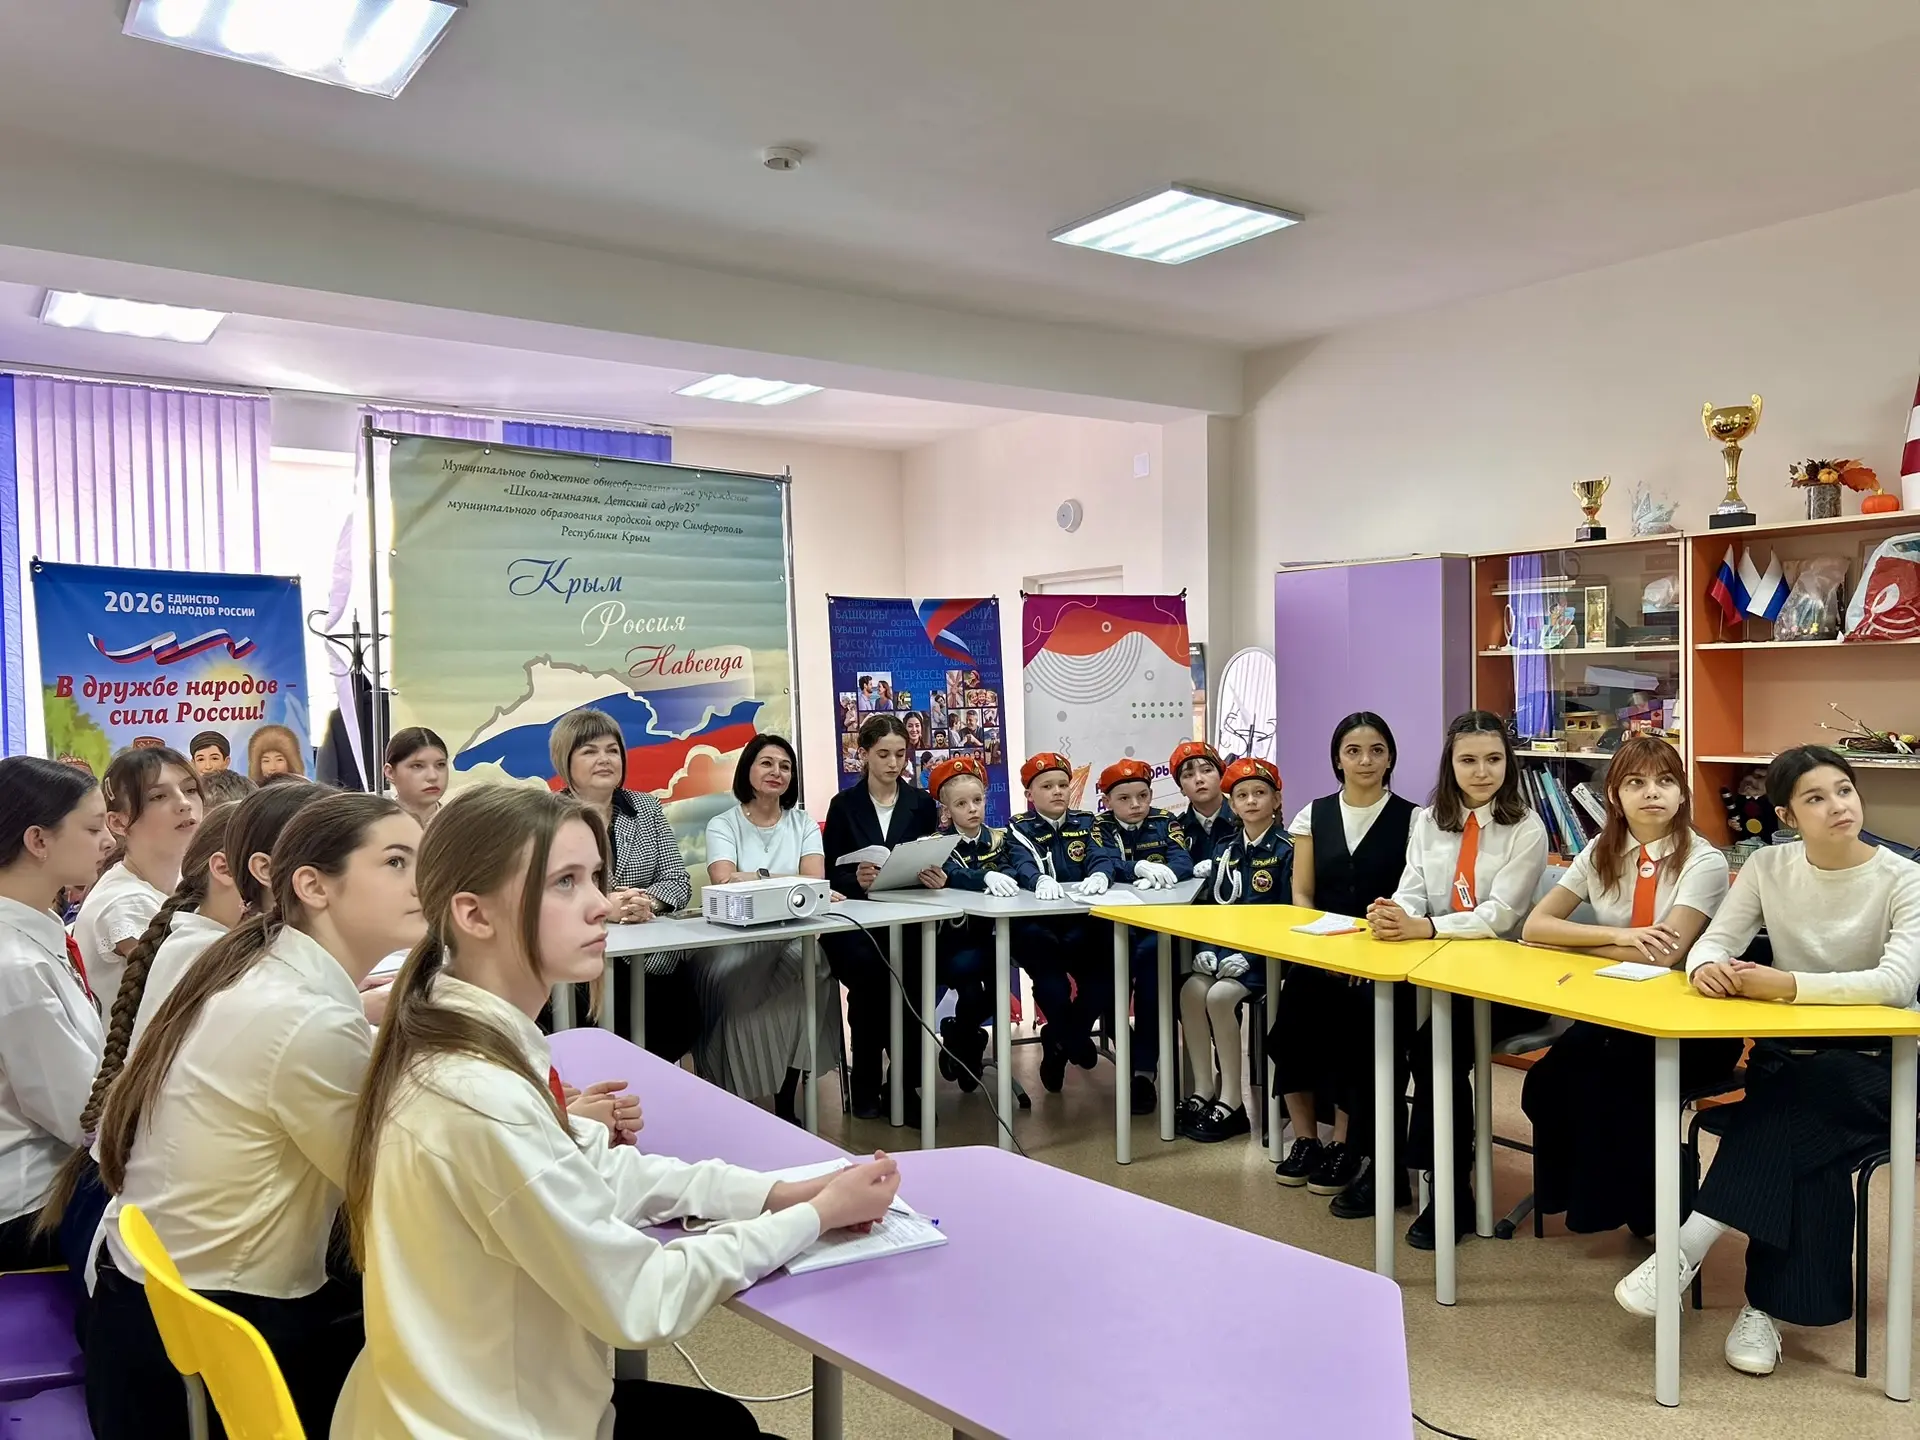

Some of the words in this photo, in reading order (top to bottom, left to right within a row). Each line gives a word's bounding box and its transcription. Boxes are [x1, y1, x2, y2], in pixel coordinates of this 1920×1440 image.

[442, 459, 526, 478] Муниципальное
[529, 468, 590, 484] бюджетное
[698, 489, 749, 503] учреждение
[604, 495, 648, 508] Детский
[651, 501, 666, 510] сад
[447, 500, 537, 517] муниципального
[540, 507, 604, 522] образования
[606, 512, 652, 526] городской
[655, 519, 680, 531] округ
[682, 519, 744, 535] Симферополь
[561, 525, 618, 541] Республики
[621, 531, 651, 544] Крым
[506, 557, 623, 604] Крым
[104, 590, 165, 614] 2026
[168, 593, 219, 605] ЕДИНСТВО
[168, 605, 215, 617] НАРОДОВ
[218, 606, 255, 617] РОССИИ
[835, 609, 888, 620] БАШКИРЫ
[580, 600, 686, 647] Россия
[832, 626, 868, 635] ЧУВАШИ
[872, 629, 917, 638] АДЫГЕЙЦЫ
[624, 644, 743, 680] Навсегда
[896, 669, 945, 680] ЧЕРКЕСЫ
[55, 676, 74, 698] В
[83, 675, 178, 704] дружбе
[186, 674, 278, 701] народов
[109, 705, 169, 725] сила
[176, 700, 266, 723] России!
